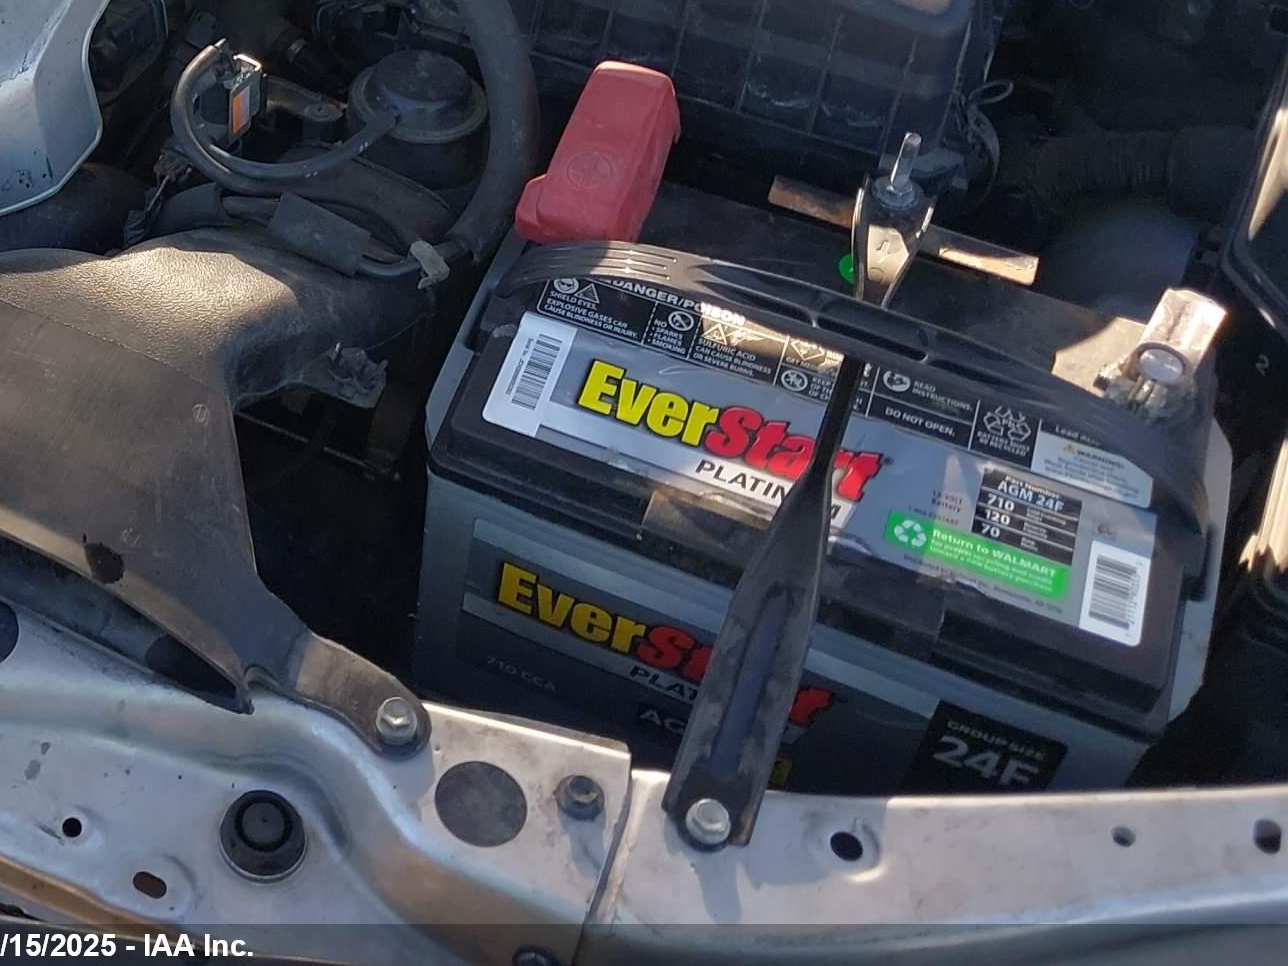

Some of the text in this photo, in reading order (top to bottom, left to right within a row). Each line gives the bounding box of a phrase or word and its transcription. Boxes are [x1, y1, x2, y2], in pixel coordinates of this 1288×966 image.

[550, 290, 576, 305] SHIELD
[543, 304, 566, 317] CAUSE
[565, 309, 603, 329] BLINDNESS
[602, 321, 614, 332] OR
[545, 297, 628, 329] EXPLOSIVE GASES CAN
[654, 318, 668, 330] NO
[653, 332, 683, 347] FLAMES
[655, 325, 684, 341] SPARKS
[650, 338, 687, 356] SMOKING
[697, 337, 758, 363] SULFURIC ACID
[692, 352, 702, 361] OR
[700, 354, 729, 370] SEVERE
[695, 345, 773, 375] CAN CAUSE BLINDNESS
[914, 380, 937, 393] READ
[884, 406, 956, 438] DO NOT OPEN.
[997, 480, 1035, 504] AGM
[1034, 494, 1066, 513] 24F
[1005, 474, 1025, 487] Part
[1024, 480, 1061, 500] Number
[987, 492, 1016, 511] 710
[983, 509, 1012, 526] 120
[981, 523, 1002, 539] 70
[932, 528, 1058, 578] Return to WALMART
[946, 719, 1009, 746] GROUP
[932, 734, 1040, 786] 24F
